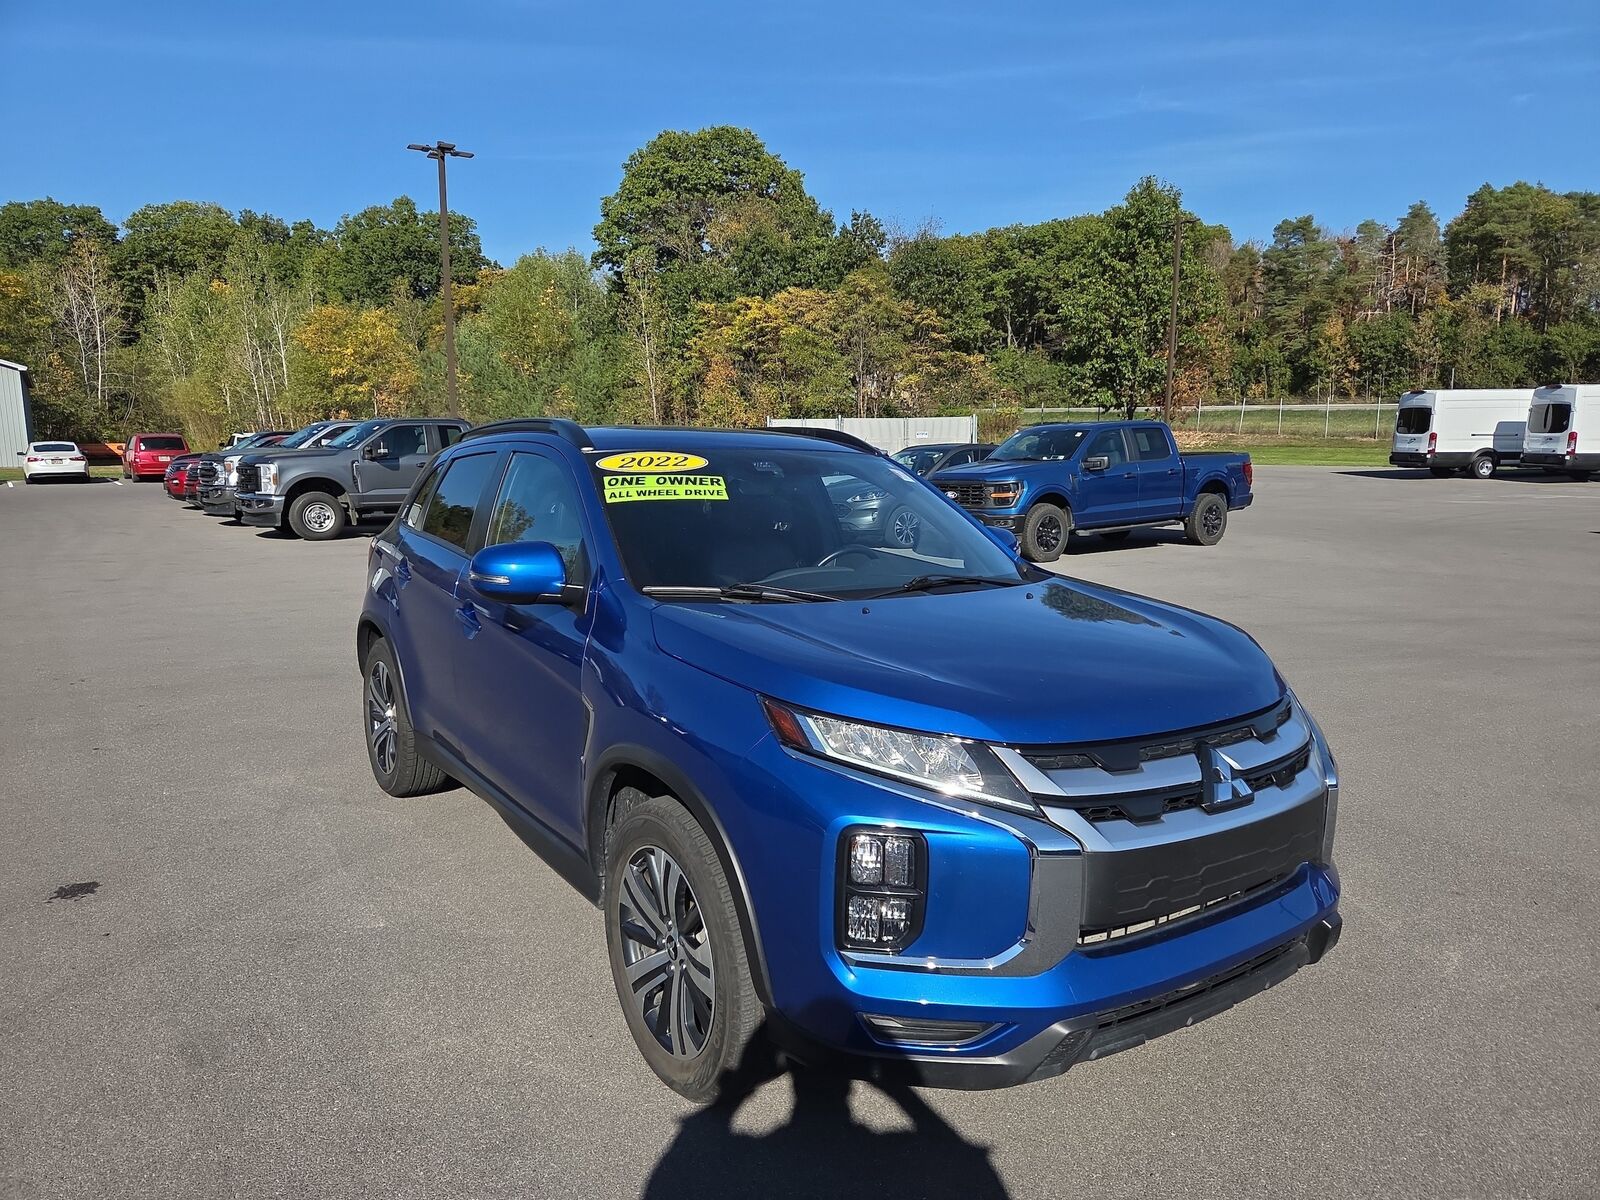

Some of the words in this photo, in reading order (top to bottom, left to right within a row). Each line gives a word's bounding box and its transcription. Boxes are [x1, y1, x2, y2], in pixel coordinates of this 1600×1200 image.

[617, 455, 690, 469] 2022
[607, 476, 647, 487] ONE
[655, 476, 723, 487] OWNER
[608, 490, 633, 499] ALL
[635, 489, 680, 497] WHEEL
[684, 489, 724, 497] DRIVE
